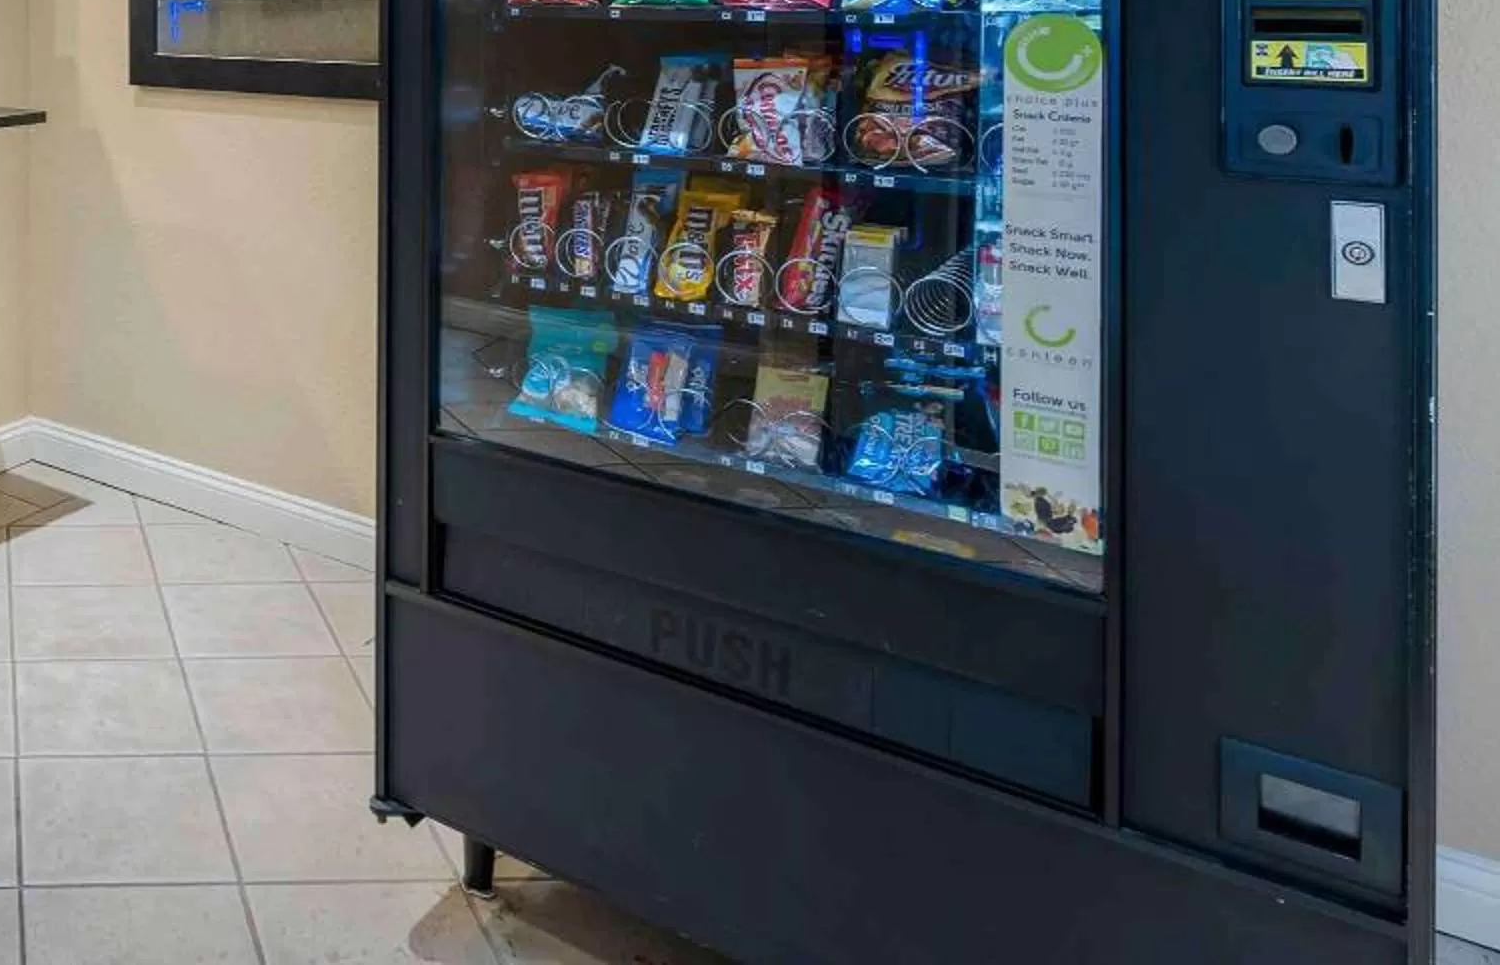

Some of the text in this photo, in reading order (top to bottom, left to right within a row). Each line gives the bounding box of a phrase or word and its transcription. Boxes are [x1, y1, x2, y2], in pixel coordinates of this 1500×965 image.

[1012, 108, 1045, 121] Snack
[1005, 224, 1046, 239] Snack
[1009, 243, 1052, 257] Snack
[1008, 260, 1051, 275] Snack
[1013, 388, 1087, 412] Follow us
[650, 608, 792, 697] PUSH
